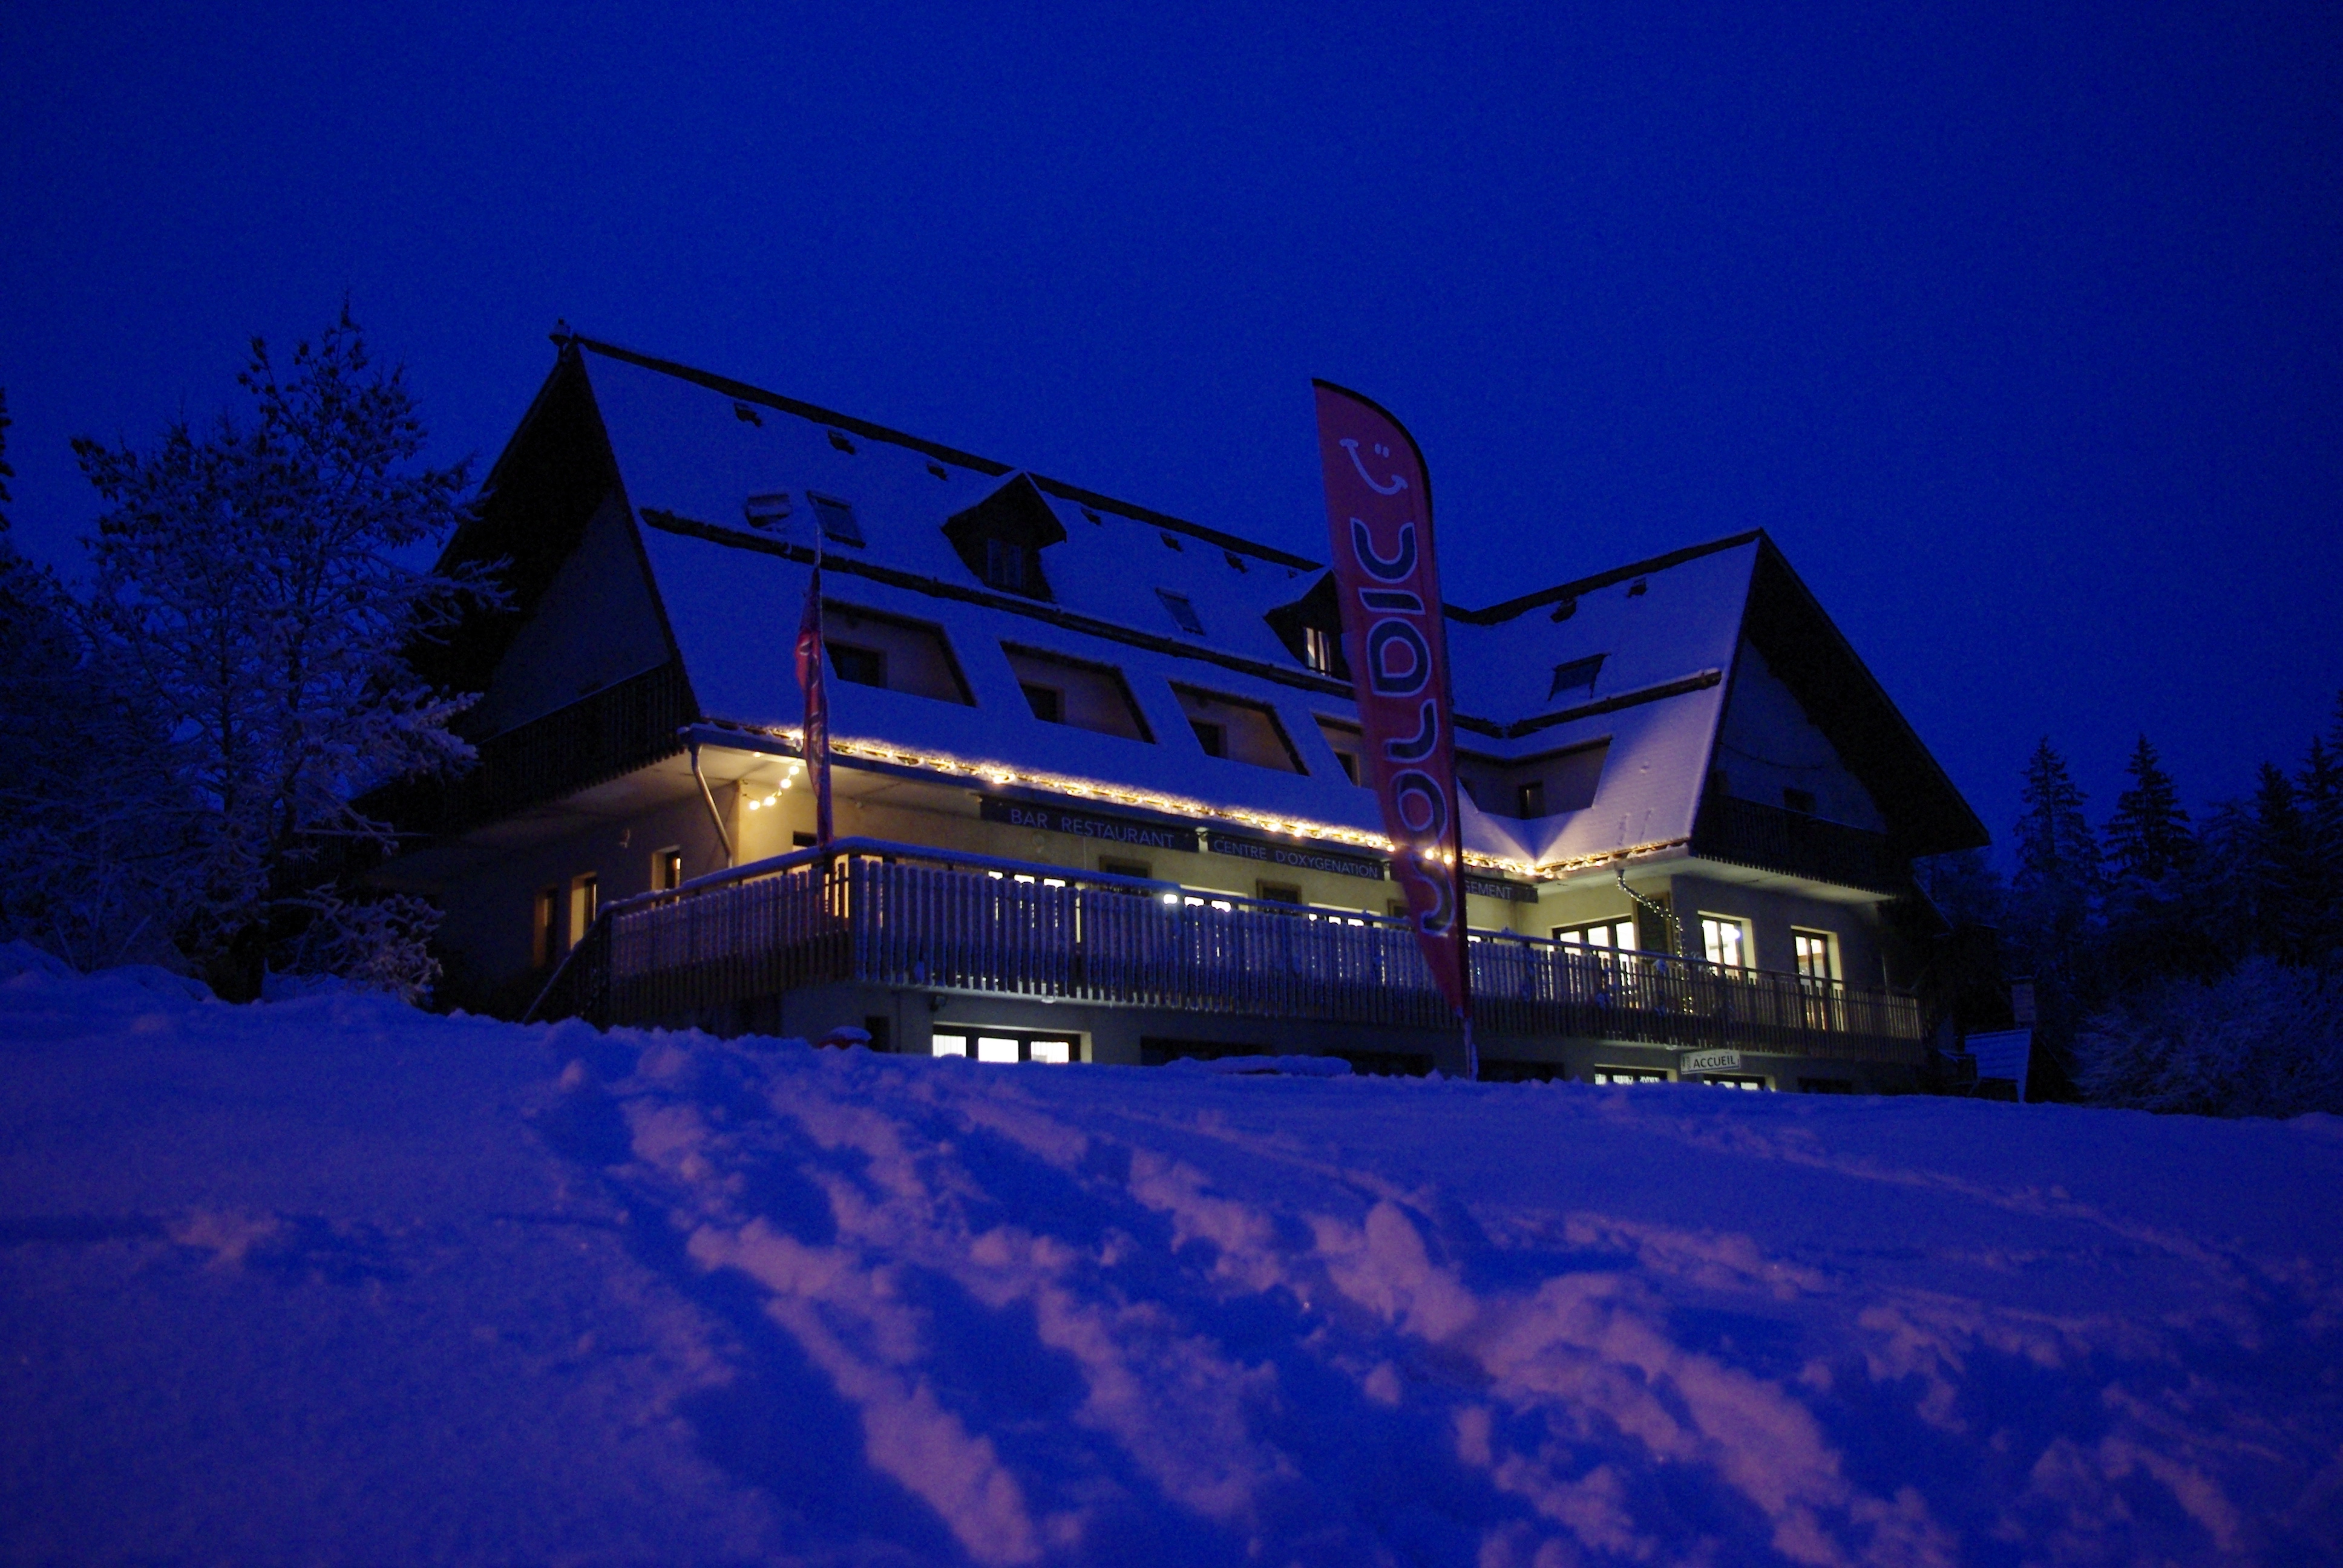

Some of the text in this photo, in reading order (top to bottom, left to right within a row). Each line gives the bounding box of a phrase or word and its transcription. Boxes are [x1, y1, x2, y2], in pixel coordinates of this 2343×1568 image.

[1010, 808, 1175, 849] BAR RESTAURANT
[1213, 838, 1268, 860] CENTRE
[1693, 1055, 1735, 1068] ACCUEIL
